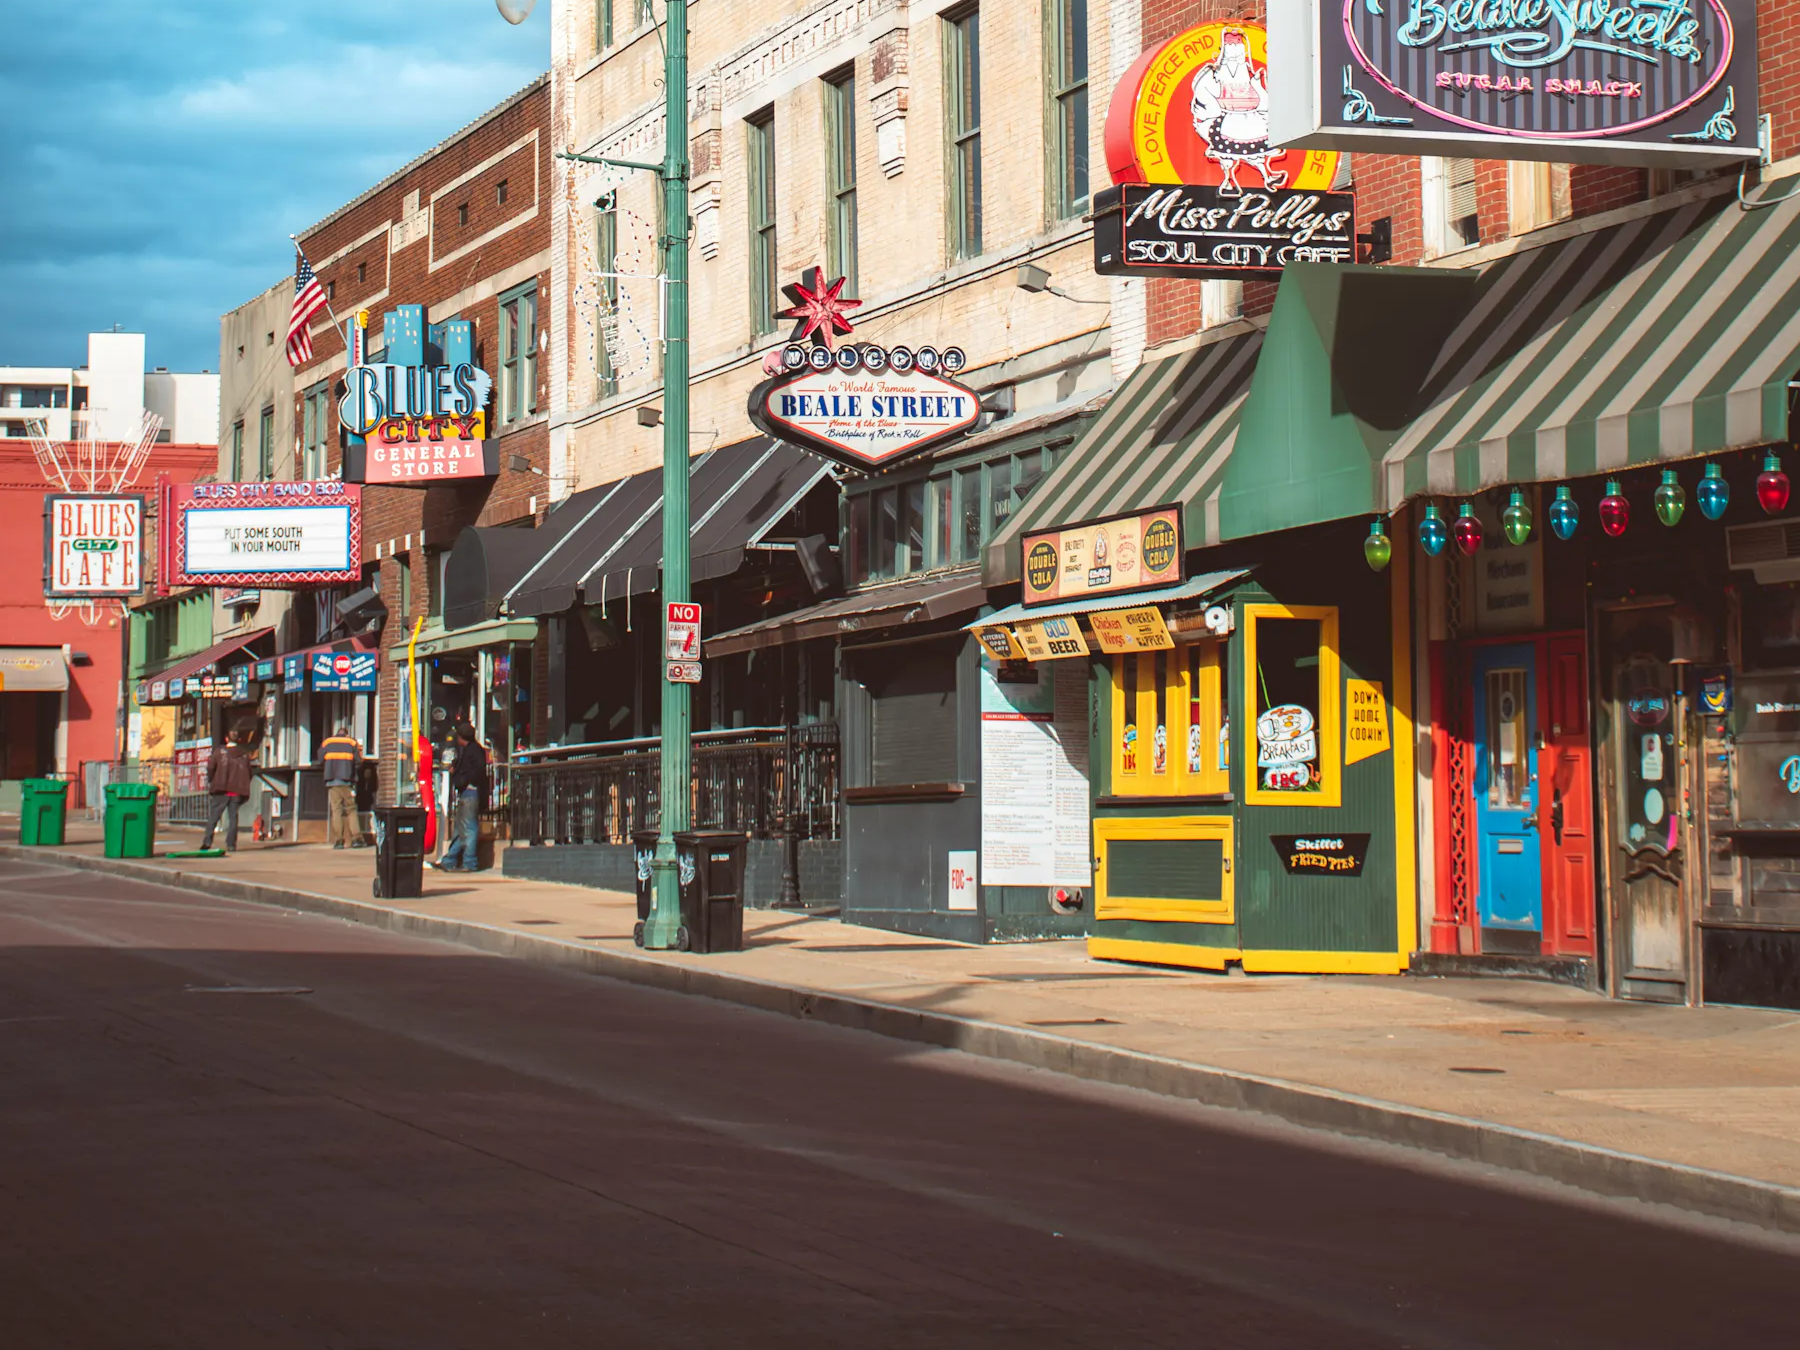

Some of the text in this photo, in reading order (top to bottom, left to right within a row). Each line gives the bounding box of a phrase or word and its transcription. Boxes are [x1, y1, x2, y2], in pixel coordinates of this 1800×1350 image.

[1436, 72, 1534, 91] SUGAR
[1145, 34, 1215, 166] LOVE, PEACE AND
[1126, 189, 1351, 244] Miss Pollys
[1128, 240, 1208, 264] SOUL
[1212, 244, 1272, 266] CITY
[782, 346, 964, 370] WELCOME
[828, 381, 917, 393] to World Famous
[357, 363, 477, 434] BLUES
[780, 394, 966, 418] BEALE STREET
[378, 418, 481, 444] CITY
[829, 419, 900, 428] Home of the Blues
[825, 429, 867, 441] Birthplace
[868, 430, 875, 441] of
[876, 429, 895, 438] Rock
[903, 430, 925, 438] Roll
[374, 444, 475, 462] GENERAL
[391, 461, 459, 477] STORE
[193, 482, 345, 498] BLUES CITY BAND BOX
[59, 503, 136, 537] BLUES
[224, 526, 303, 540] PUT SOME SOUTH
[1145, 531, 1174, 550] DOUBLE
[74, 539, 117, 550] CITY
[231, 540, 301, 552] IN YOUR MOUTH
[59, 540, 135, 586] CAFE
[1029, 553, 1056, 570] DOUBLE
[1150, 550, 1169, 566] COLA
[1033, 571, 1052, 586] COLA
[674, 606, 694, 620] NO
[670, 624, 695, 632] PARKING
[1043, 619, 1070, 638] COLD
[1092, 616, 1122, 630] Chicken
[982, 633, 1005, 641] KITCHEN
[1101, 632, 1125, 647] Wings
[1048, 639, 1081, 655] BEER
[336, 660, 350, 669] STOP
[1354, 691, 1378, 704] DOWN
[1354, 710, 1379, 723] HOME
[1350, 728, 1384, 741] COOKIN'
[1262, 739, 1312, 760] BREAKFAST
[1271, 771, 1300, 787] IBC
[1295, 838, 1344, 850] Skillet
[1291, 853, 1355, 870] FRIED PIES
[951, 869, 965, 890] FDC
